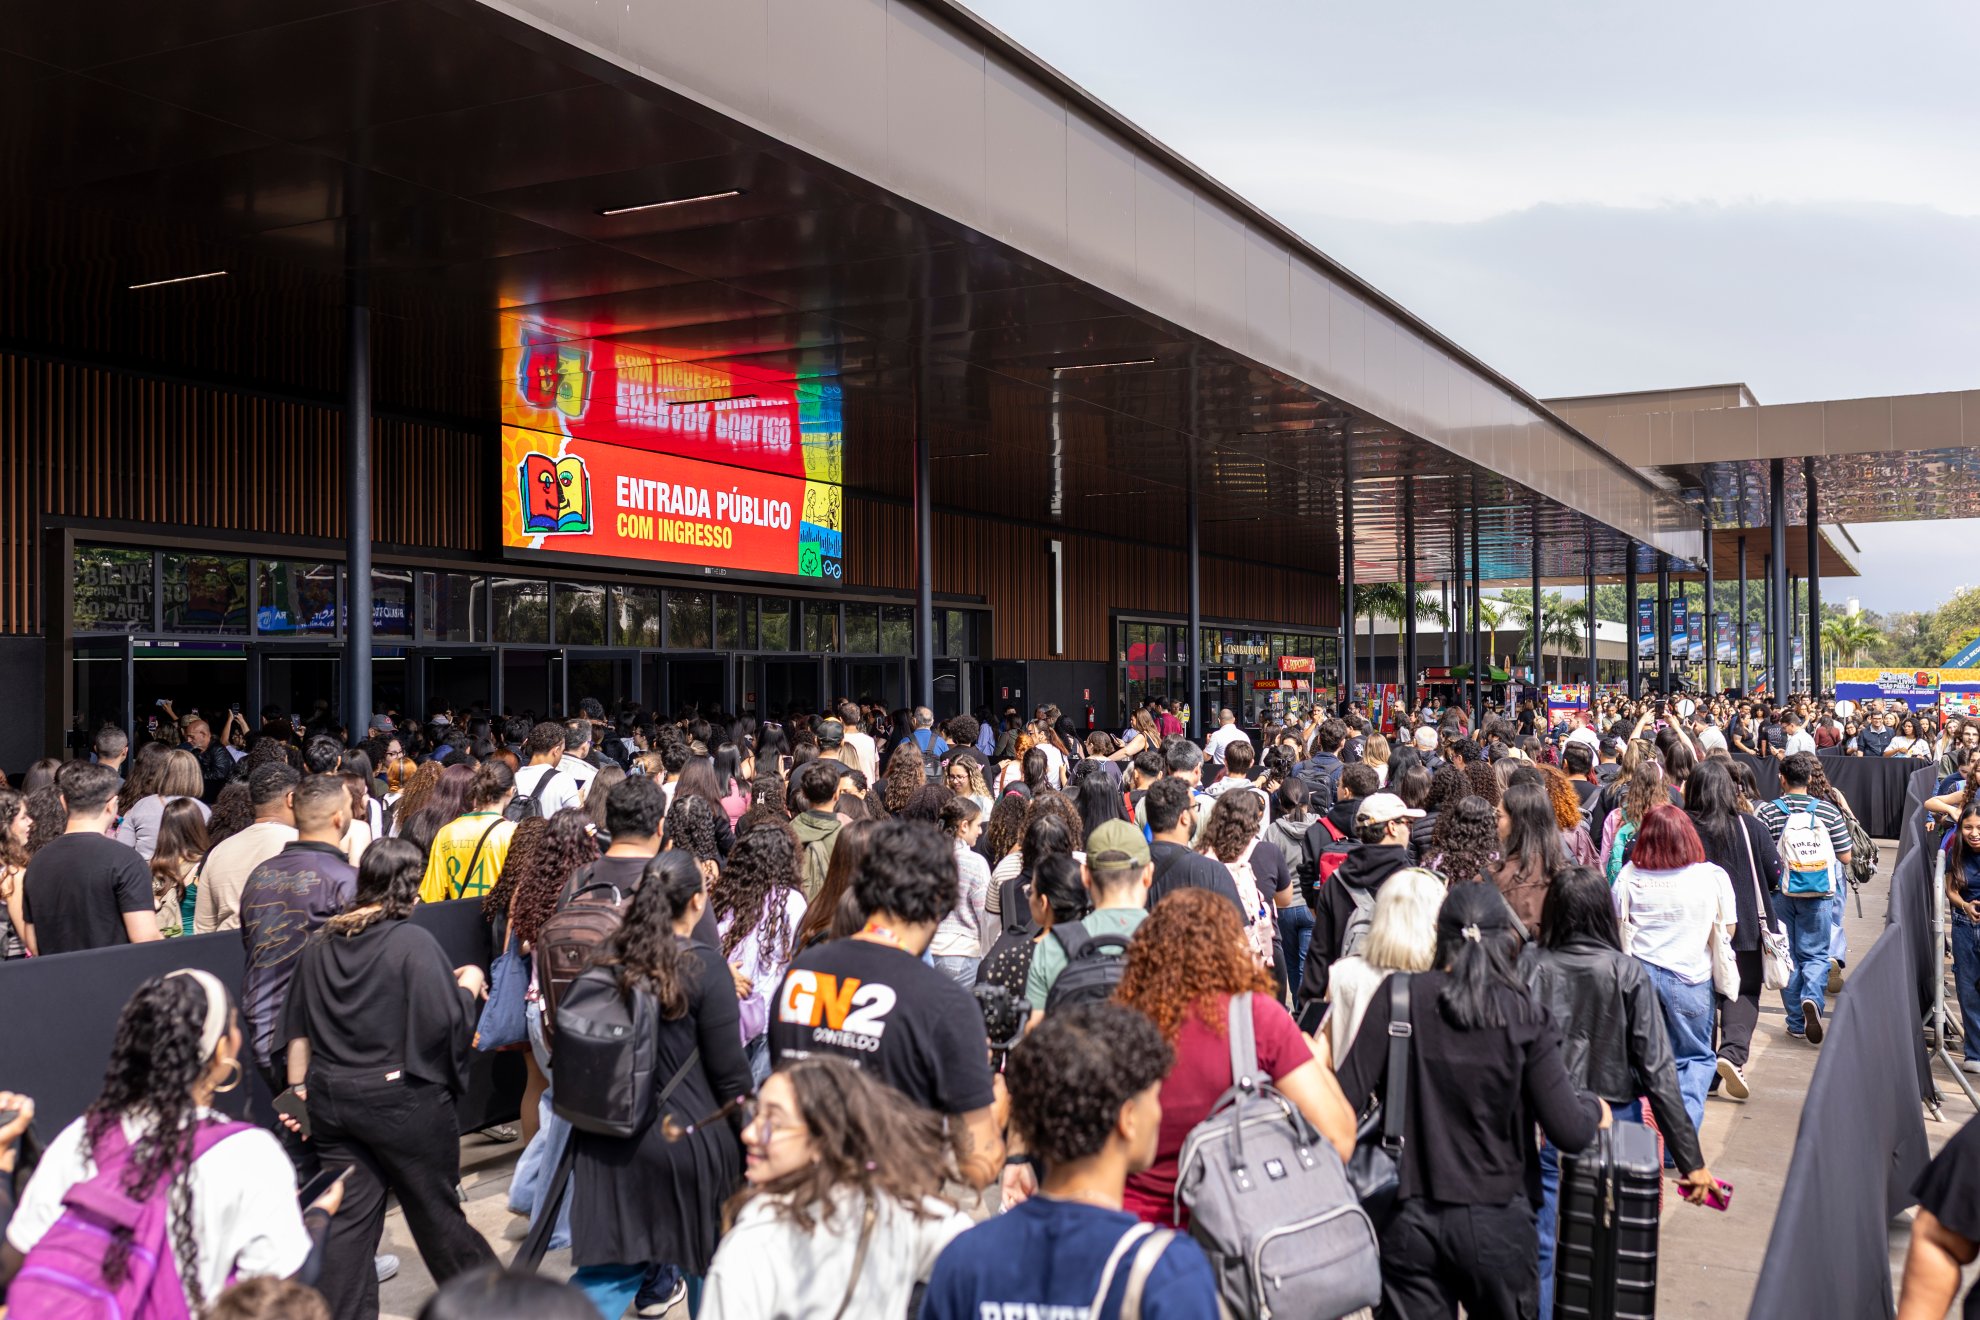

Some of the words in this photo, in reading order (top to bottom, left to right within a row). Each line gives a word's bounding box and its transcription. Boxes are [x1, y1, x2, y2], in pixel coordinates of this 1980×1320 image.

[616, 475, 712, 519] ENTRADA
[716, 487, 792, 530] PÚBLICO
[616, 513, 653, 539] COM
[658, 520, 733, 550] INGRESSO
[446, 855, 491, 898] 84
[779, 968, 897, 1038] GN2
